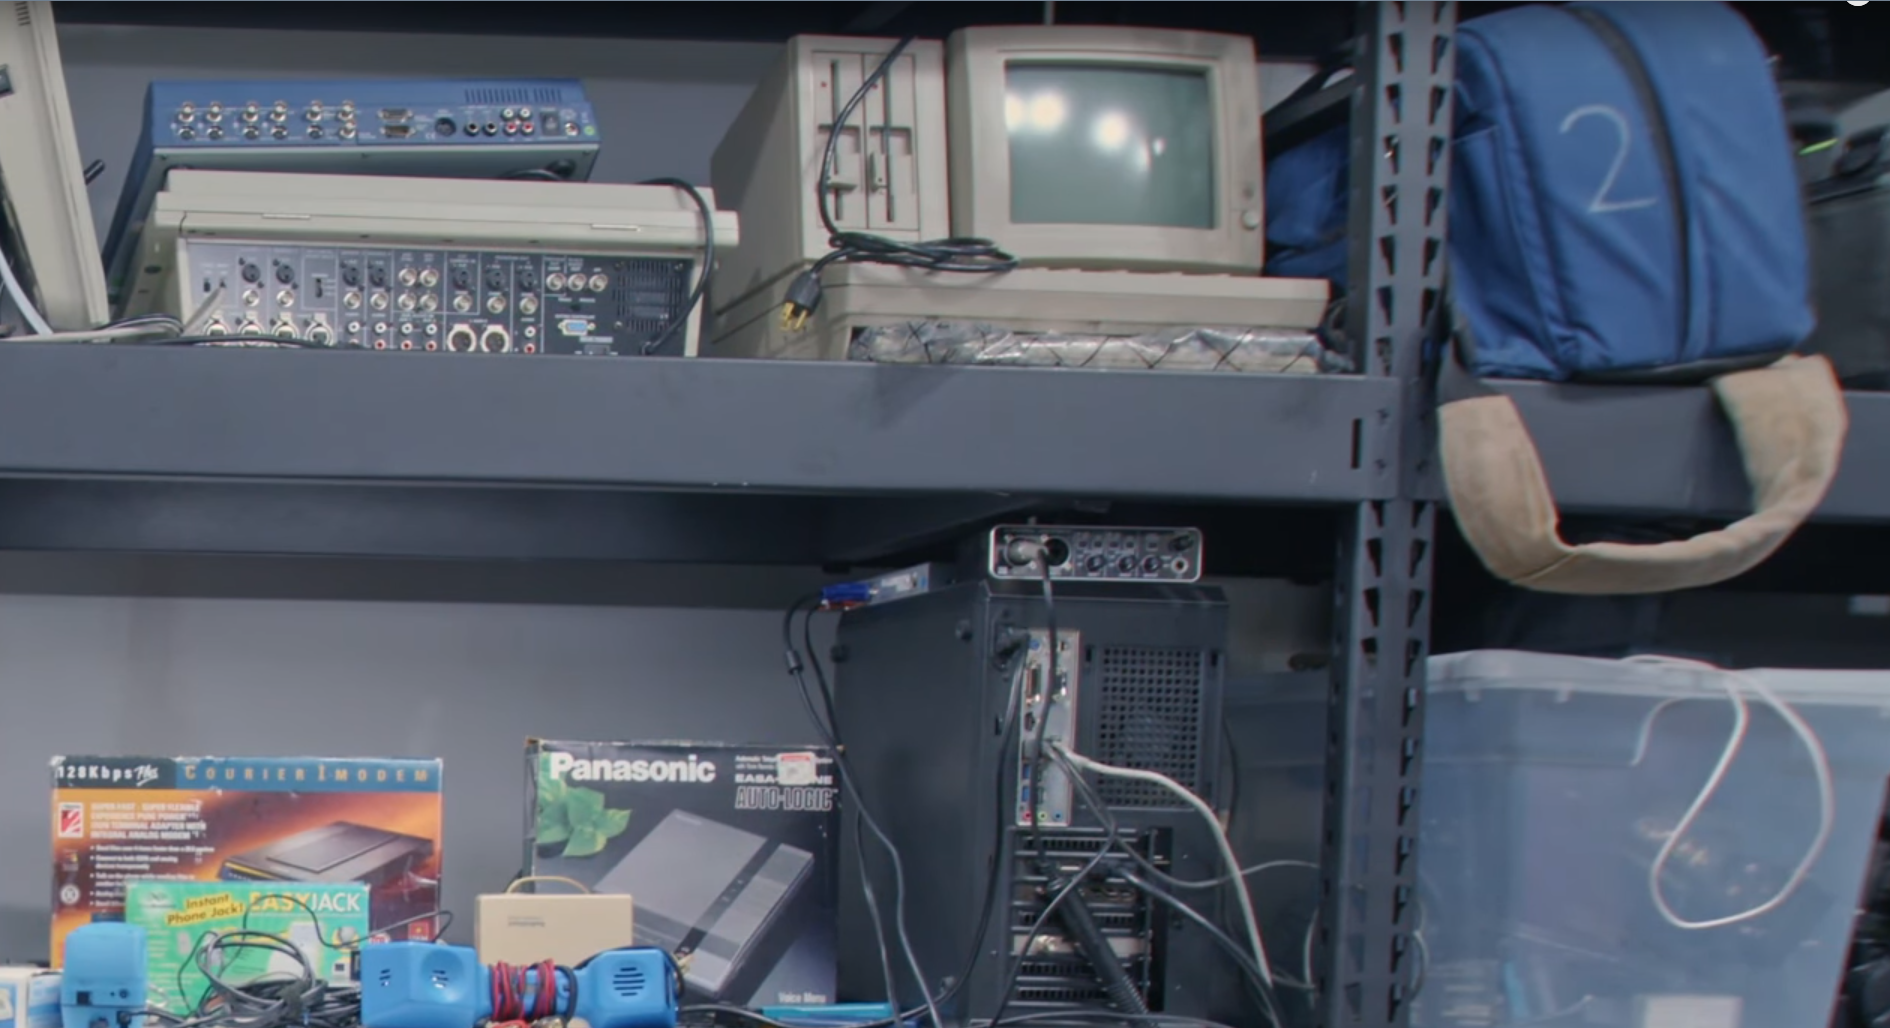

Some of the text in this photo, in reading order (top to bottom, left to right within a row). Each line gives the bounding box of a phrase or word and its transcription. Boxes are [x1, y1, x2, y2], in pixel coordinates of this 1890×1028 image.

[1558, 104, 1658, 213] 2
[55, 765, 133, 782] 128Kbps
[185, 764, 305, 781] COURIER
[550, 752, 716, 783] Panasonic
[735, 774, 833, 785] EASA-NE
[186, 894, 230, 910] Instant
[167, 903, 244, 925] Phone Jack!
[778, 991, 802, 1003] Voice
